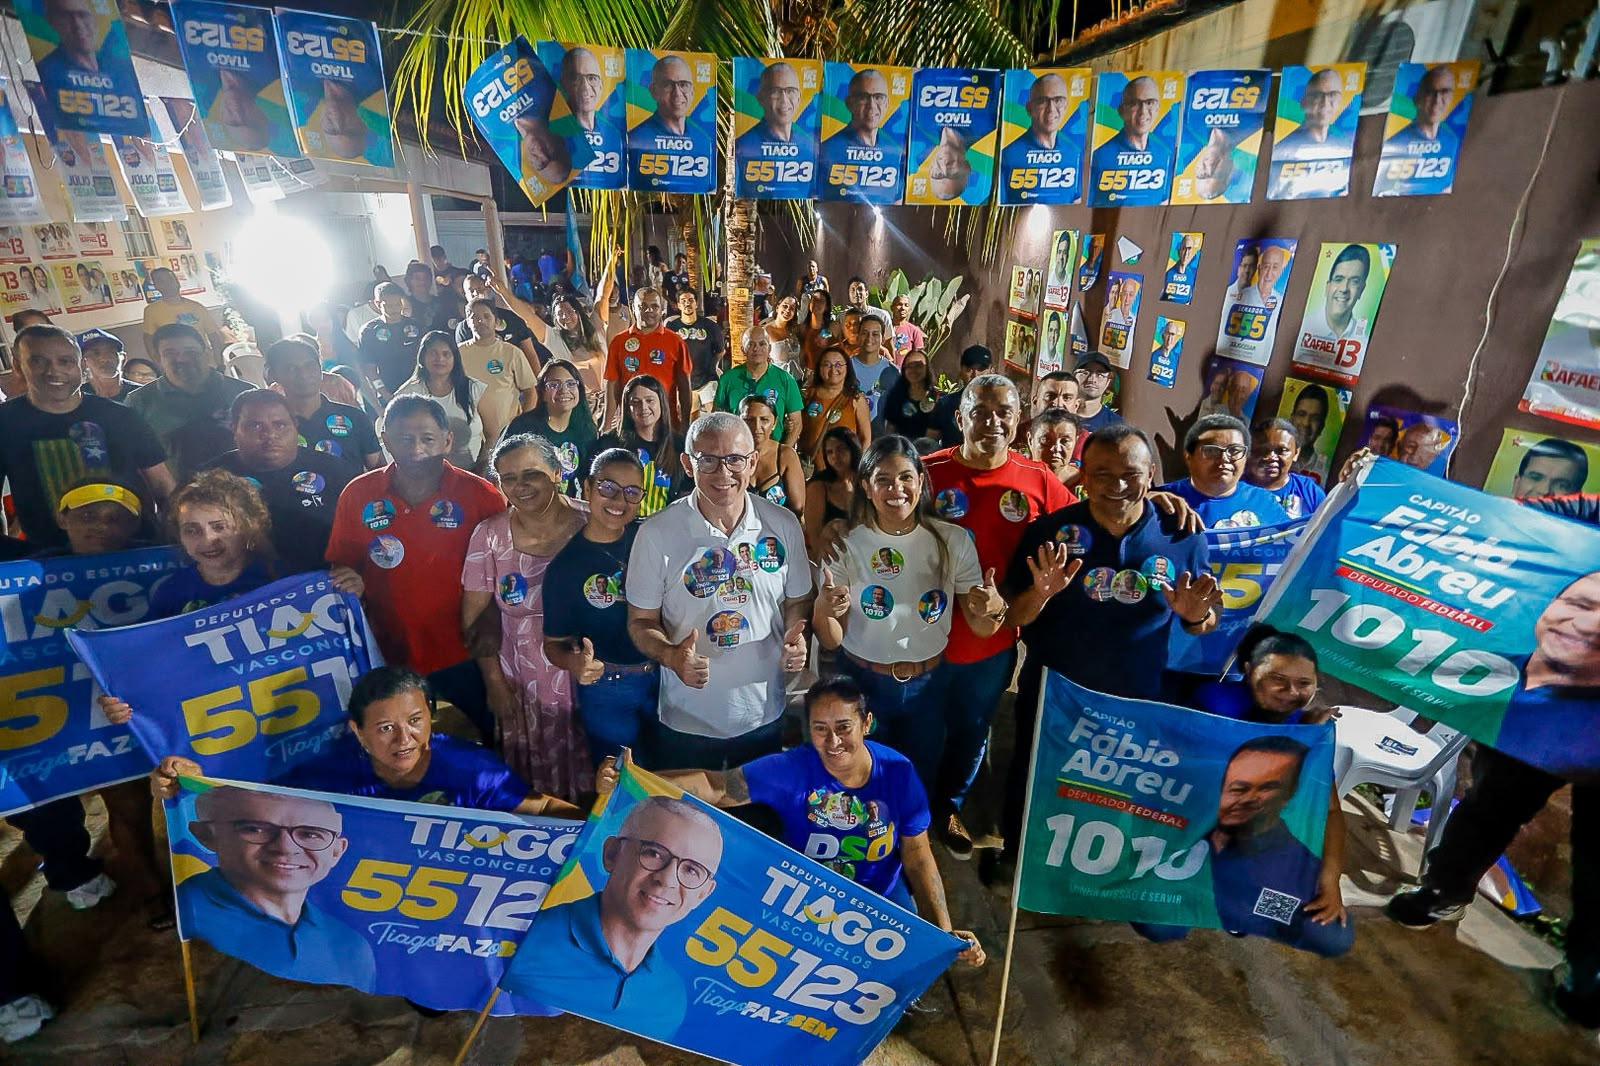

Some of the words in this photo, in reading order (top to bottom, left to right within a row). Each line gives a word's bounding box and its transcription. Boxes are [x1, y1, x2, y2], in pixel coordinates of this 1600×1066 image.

[184, 20, 264, 52] 55123
[287, 31, 365, 63] 55123
[207, 52, 250, 68] TIAGO
[311, 62, 354, 79] TIAGO
[68, 73, 113, 89] TIAGO
[472, 58, 534, 117] 55123
[58, 89, 137, 119] 55123
[500, 92, 534, 122] TIAGO
[920, 85, 990, 108] 55123
[1192, 86, 1260, 110] 55123
[935, 112, 972, 124] TIAGO
[1204, 113, 1240, 124] TIAGO
[654, 138, 693, 150] TIAGO
[761, 145, 798, 157] TIAGO
[1408, 142, 1440, 155] TIAGO
[640, 154, 709, 177] 55123
[846, 150, 883, 162] TIAGO
[1026, 152, 1062, 164] TIAGO
[1117, 154, 1152, 166] TIAGO
[745, 160, 813, 182] 55123
[829, 164, 897, 188] 55123
[1010, 167, 1076, 189] 55123
[1098, 168, 1166, 190] 55123
[1386, 157, 1451, 179] 55123
[8, 238, 24, 254] 13
[96, 233, 108, 248] 13
[62, 266, 73, 279] 13
[169, 258, 180, 272] 13
[0, 271, 20, 290] 13
[1166, 282, 1190, 295] 55123
[1060, 286, 1068, 302] 13
[1238, 305, 1264, 314] SENADOR
[1228, 311, 1266, 338] 555
[1300, 333, 1336, 354] RAFAEL
[1334, 338, 1361, 368] 13
[1152, 364, 1174, 379] 55123
[1541, 360, 1600, 391] RAFAE
[1408, 494, 1480, 524] CAPITÃO
[370, 518, 388, 529] 1010
[1371, 504, 1518, 570] Fábio
[86, 562, 189, 580] ESTADUAL
[892, 565, 900, 574] 13
[1346, 535, 1516, 609] Abreu
[604, 594, 613, 603] 13
[738, 594, 747, 604] 13
[1348, 570, 1419, 606] DEPUTADO
[1419, 599, 1488, 631] FEDERAL
[194, 592, 297, 628] DEPUTADO
[864, 608, 884, 616] 1010
[1296, 588, 1520, 696] 1010
[1083, 706, 1136, 730] CAPITÃO
[68, 735, 132, 766] FAZ
[1067, 716, 1180, 767] Fábio
[1060, 748, 1194, 805] Abreu
[1067, 788, 1126, 810] DEPUTADO
[1128, 804, 1184, 828] FEDERAL
[846, 815, 856, 825] 13
[1046, 814, 1210, 881] 1010
[416, 849, 559, 876] VASCONCELO
[341, 858, 550, 931] 5512
[780, 860, 846, 898] DEPUTADO
[850, 896, 912, 935] ESTADUAL
[1148, 891, 1182, 904] SERVIR
[760, 866, 906, 961] TIAGO
[368, 921, 440, 954] Tiago
[436, 933, 492, 958] FAZ
[760, 909, 872, 970] VASCONCELOS
[685, 906, 896, 1026] 55123
[693, 976, 749, 1016] Tiago
[740, 1000, 785, 1024] FAZ
